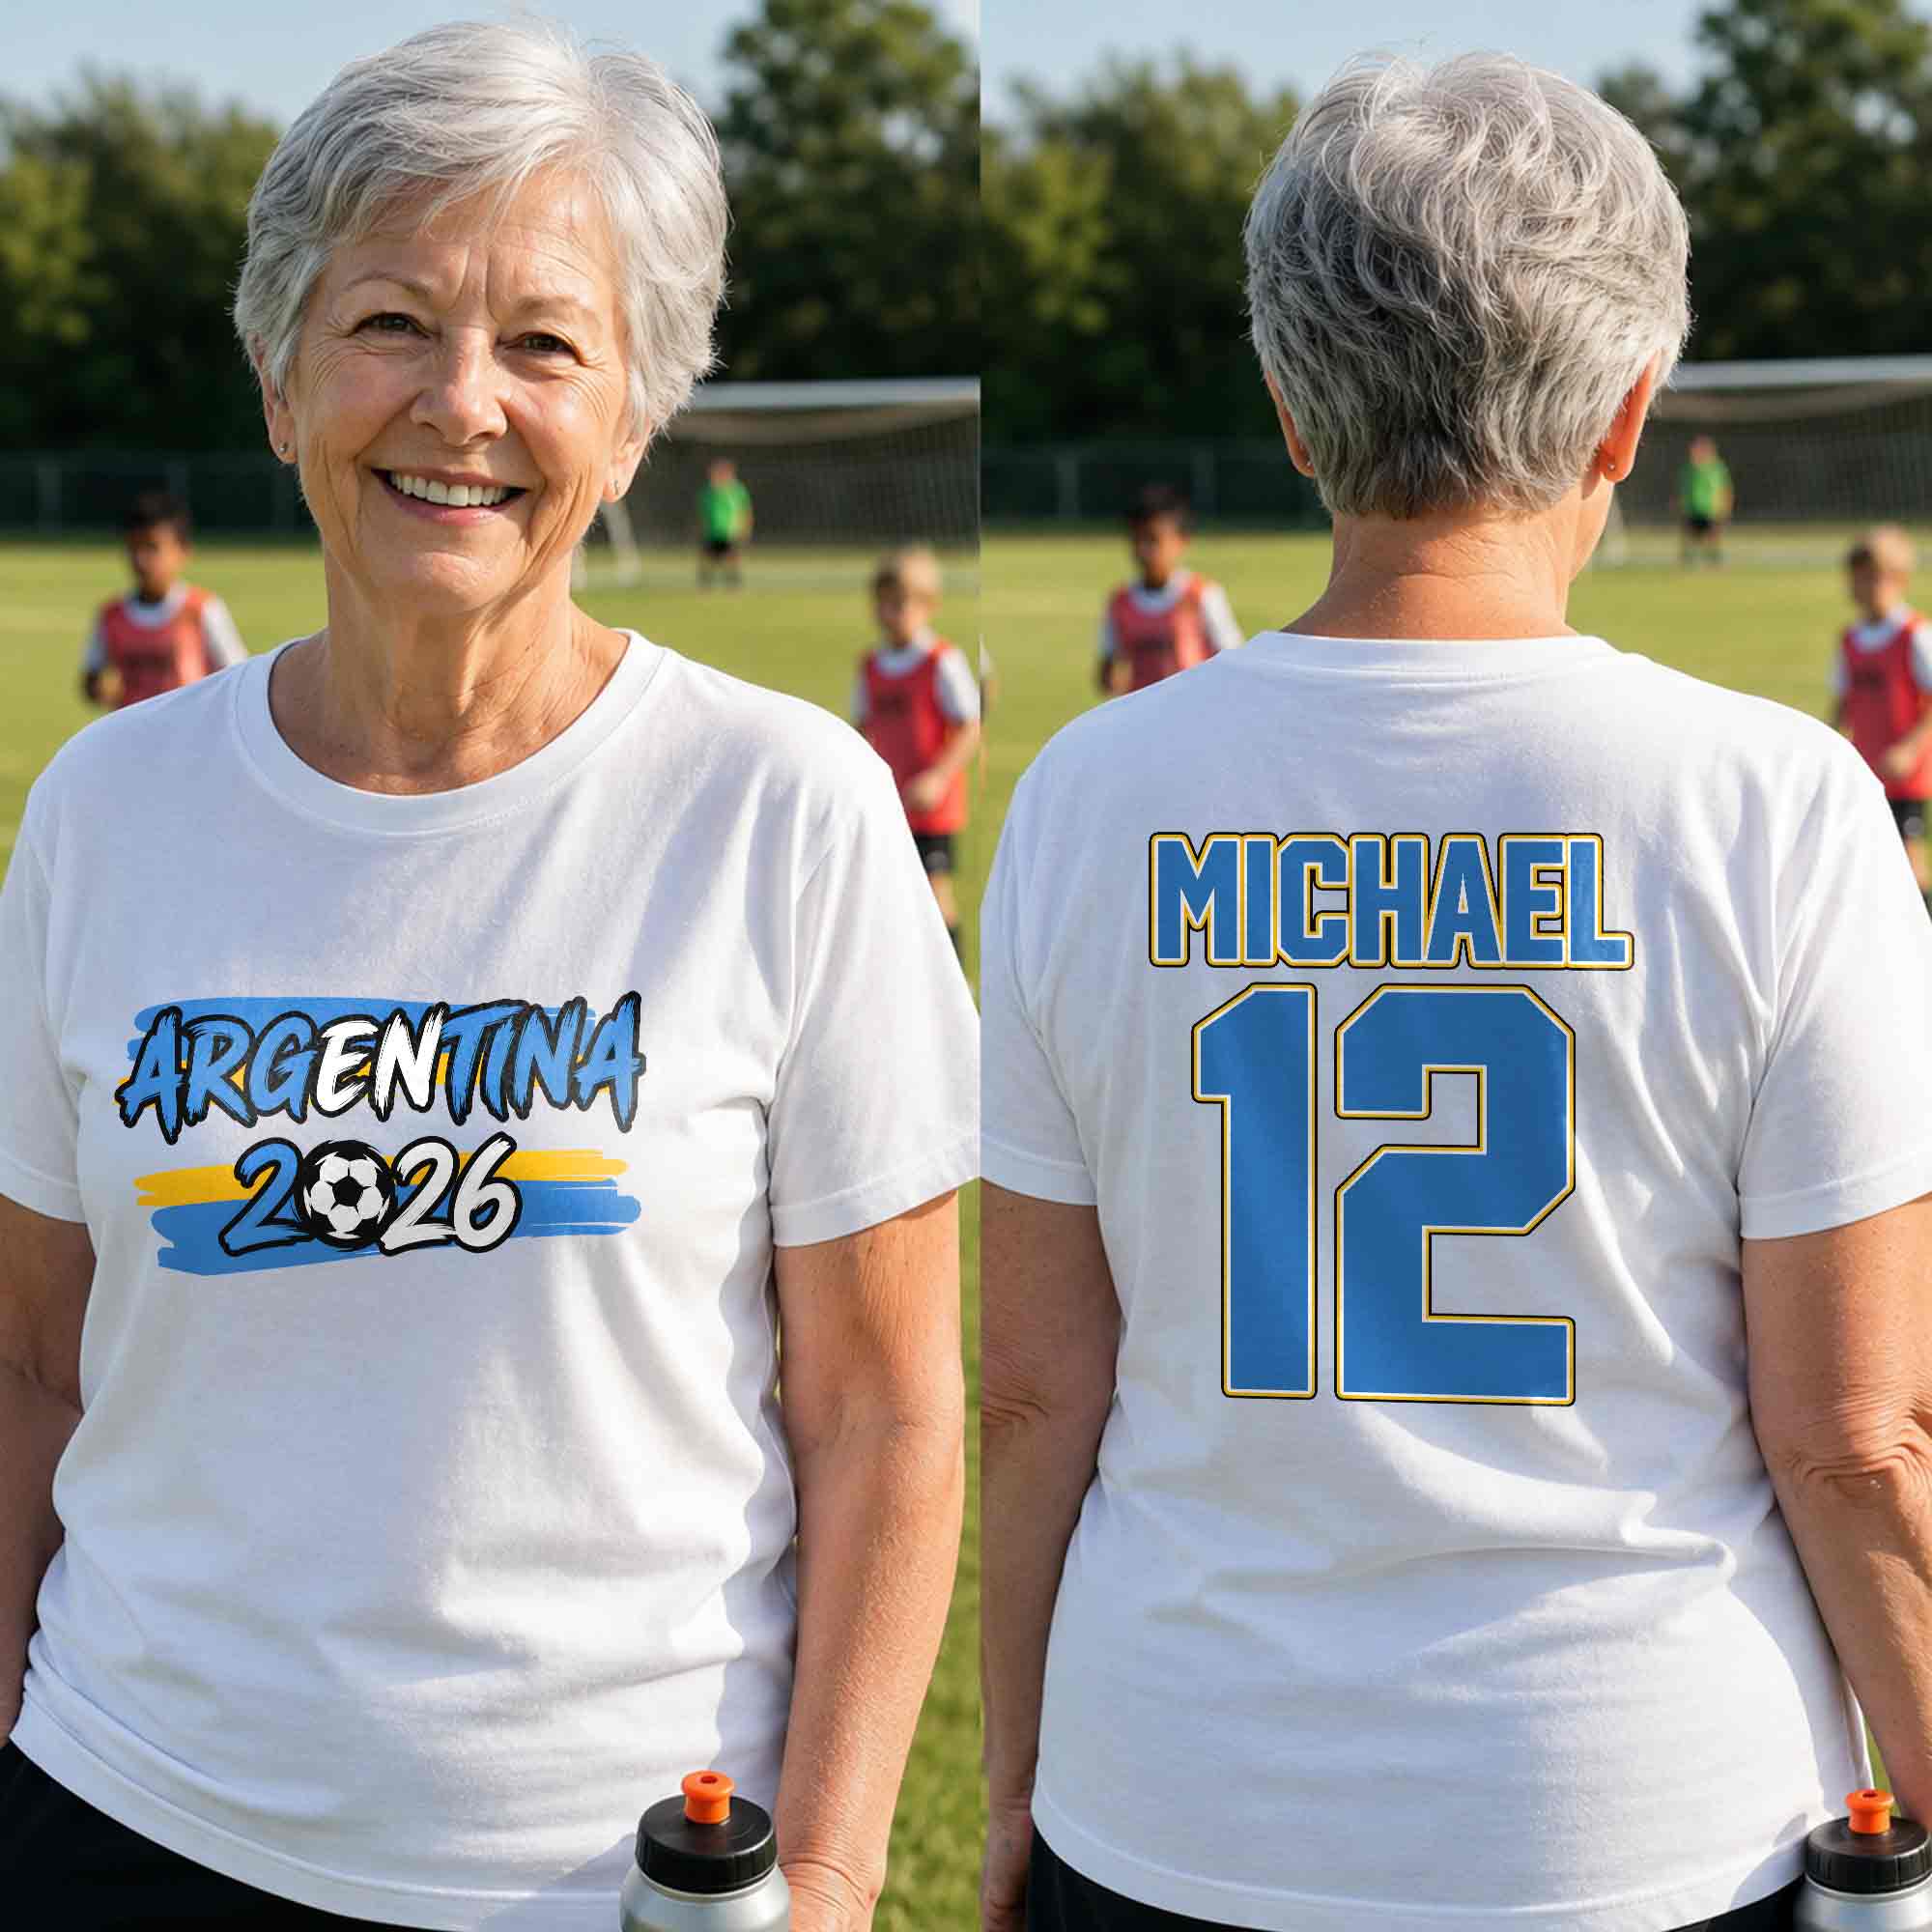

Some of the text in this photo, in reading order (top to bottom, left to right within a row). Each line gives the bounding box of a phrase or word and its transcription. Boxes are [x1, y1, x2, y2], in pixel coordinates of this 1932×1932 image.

[1150, 832, 1634, 971] MICHAEL
[114, 990, 646, 1145] ARGENTINA
[1192, 983, 1576, 1406] 12
